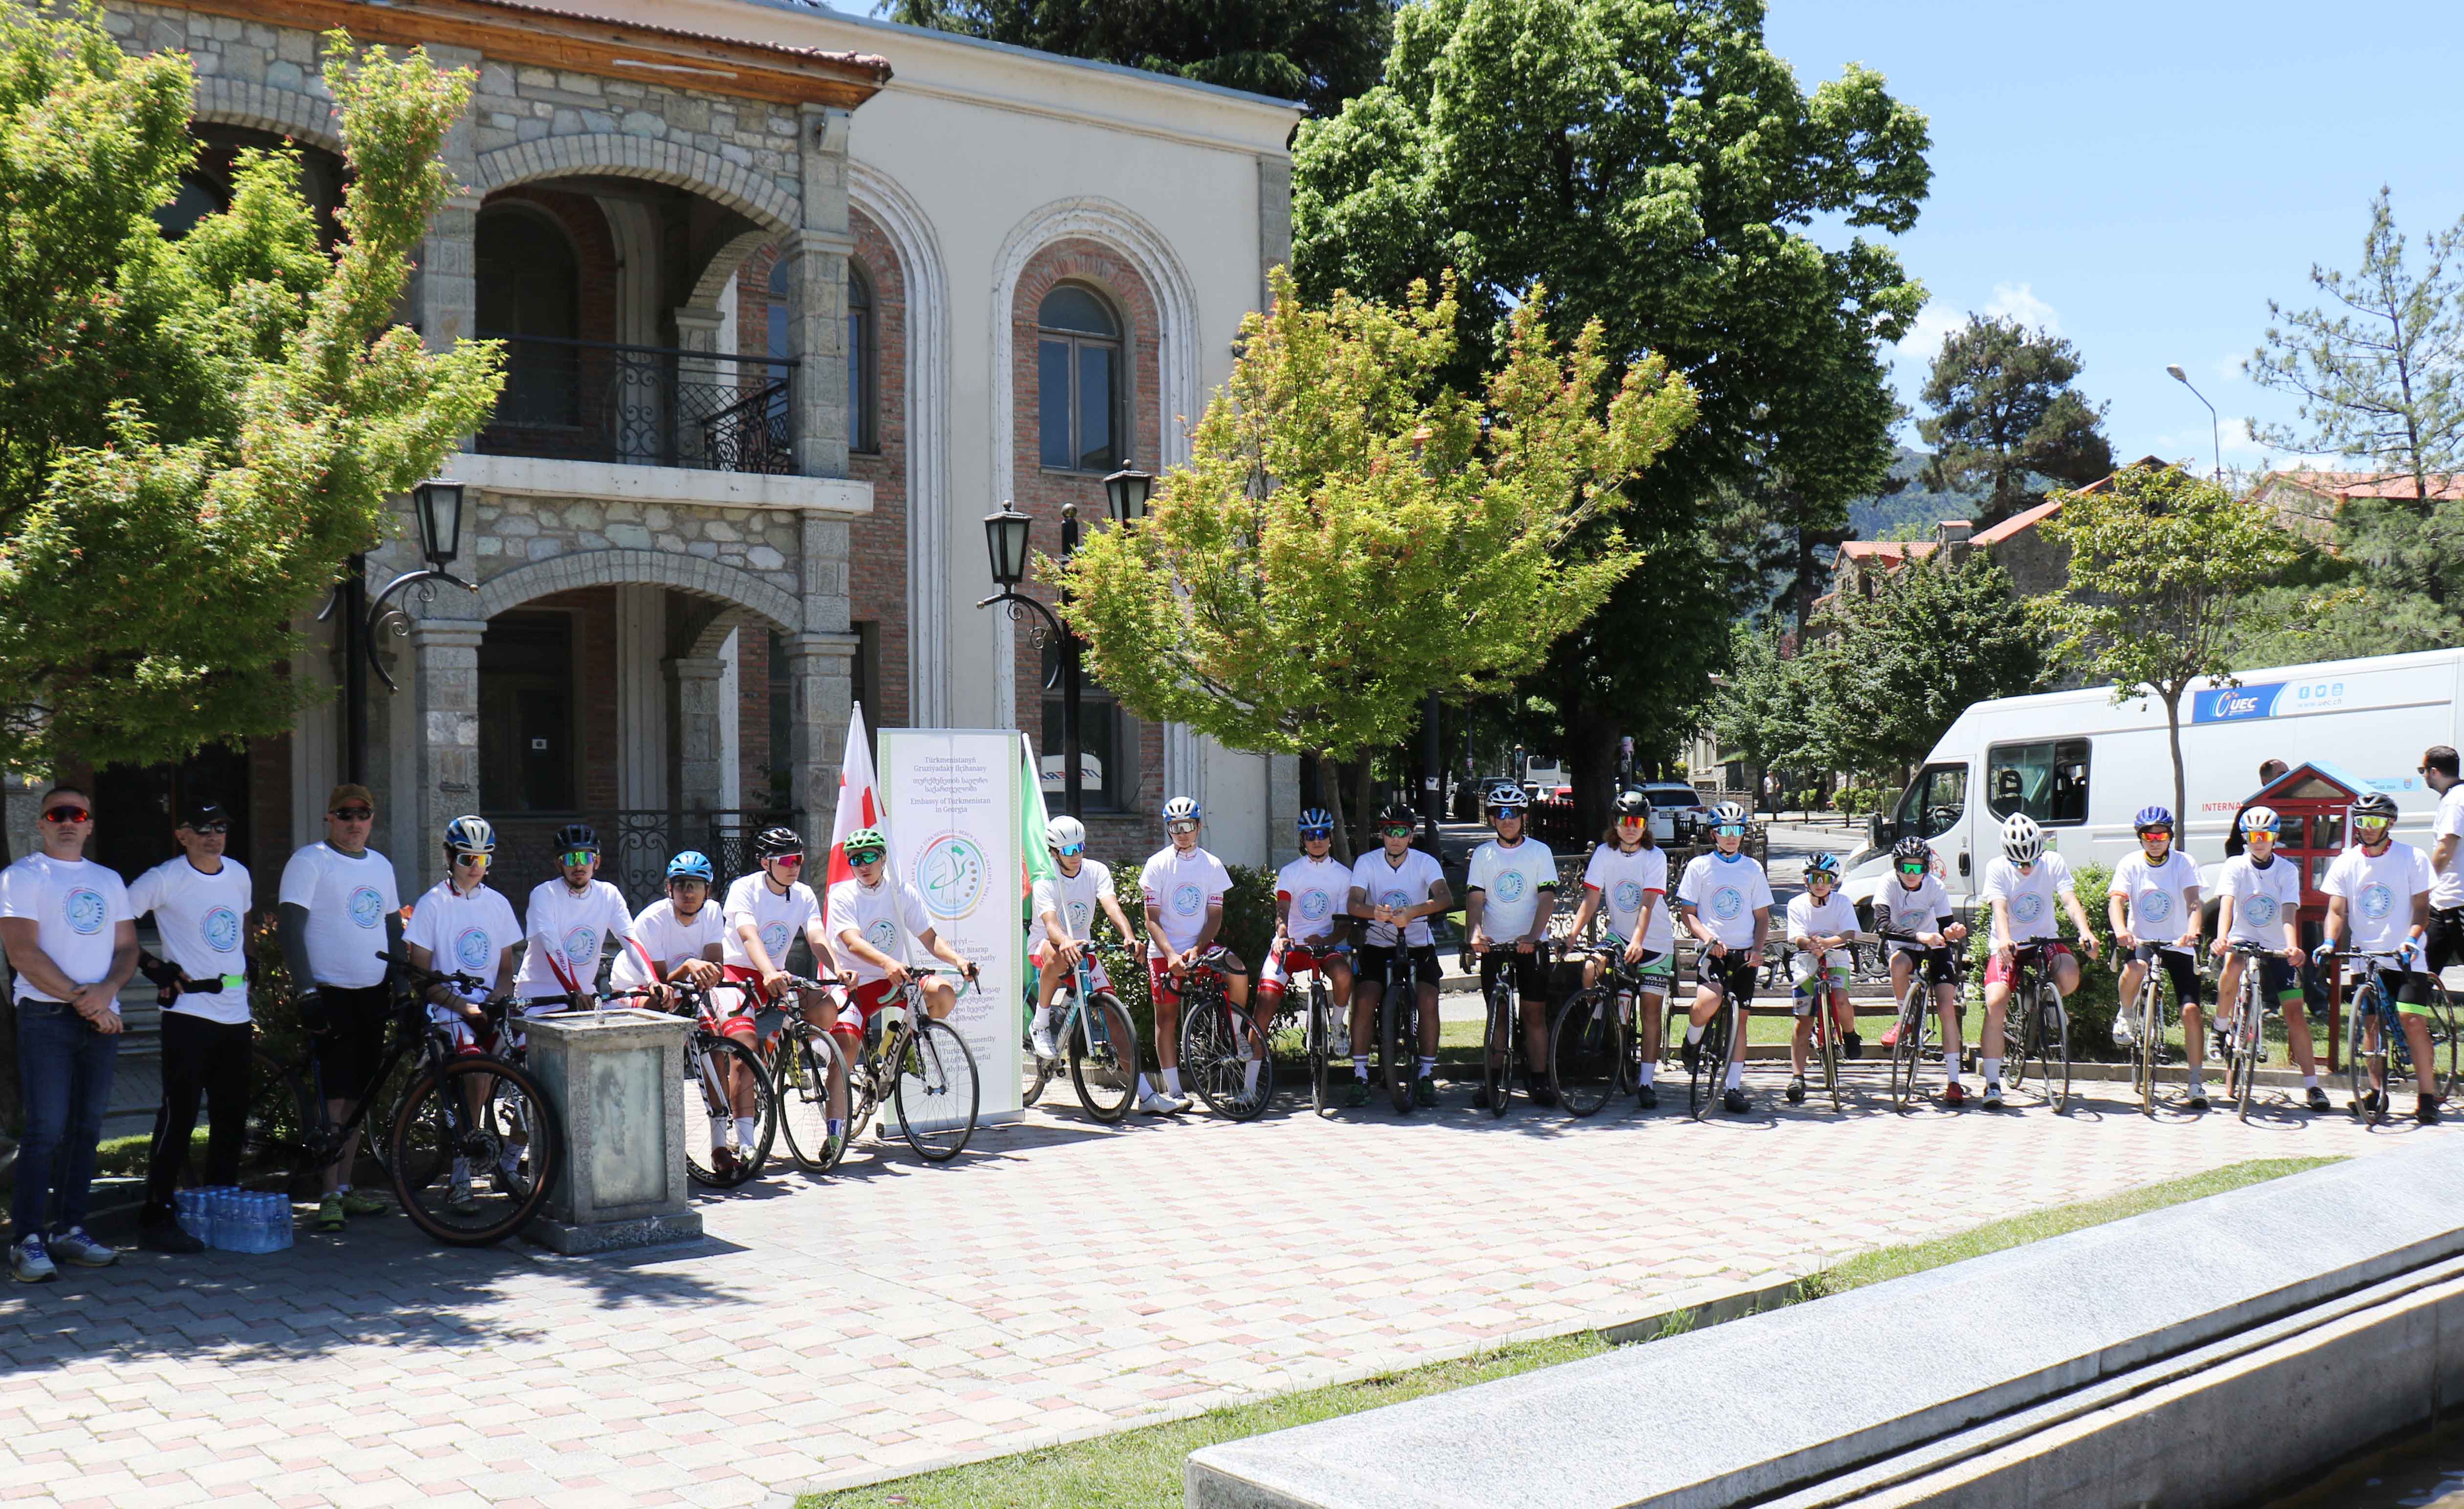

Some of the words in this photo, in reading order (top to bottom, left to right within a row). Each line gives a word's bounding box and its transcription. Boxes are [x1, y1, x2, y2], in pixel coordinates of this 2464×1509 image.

[2230, 697, 2259, 710] UEC
[2202, 802, 2242, 812] INTERNA
[792, 1039, 801, 1086] SCOTT
[883, 1021, 907, 1076] FOCUS
